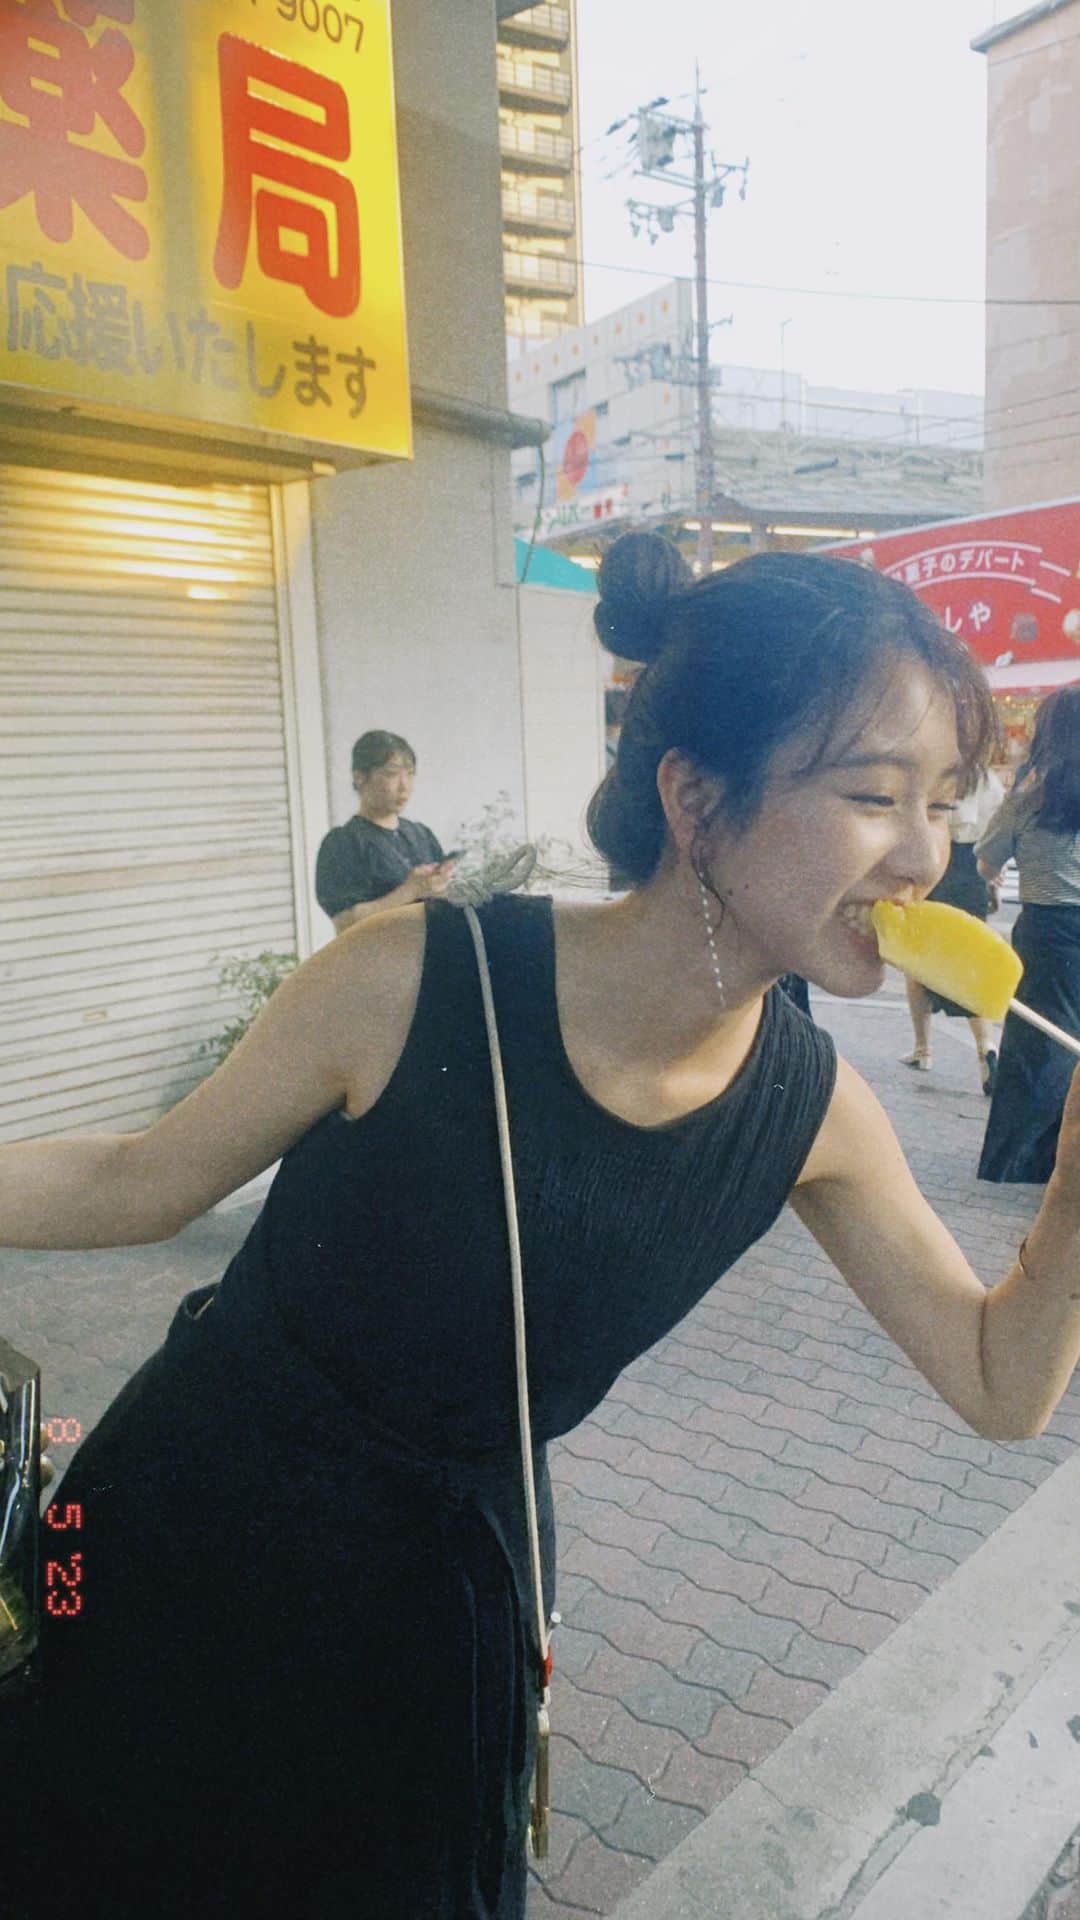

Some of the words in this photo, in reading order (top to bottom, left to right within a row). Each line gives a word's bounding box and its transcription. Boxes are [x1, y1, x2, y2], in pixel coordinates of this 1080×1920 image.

[6, 261, 377, 419] 応援いたします
